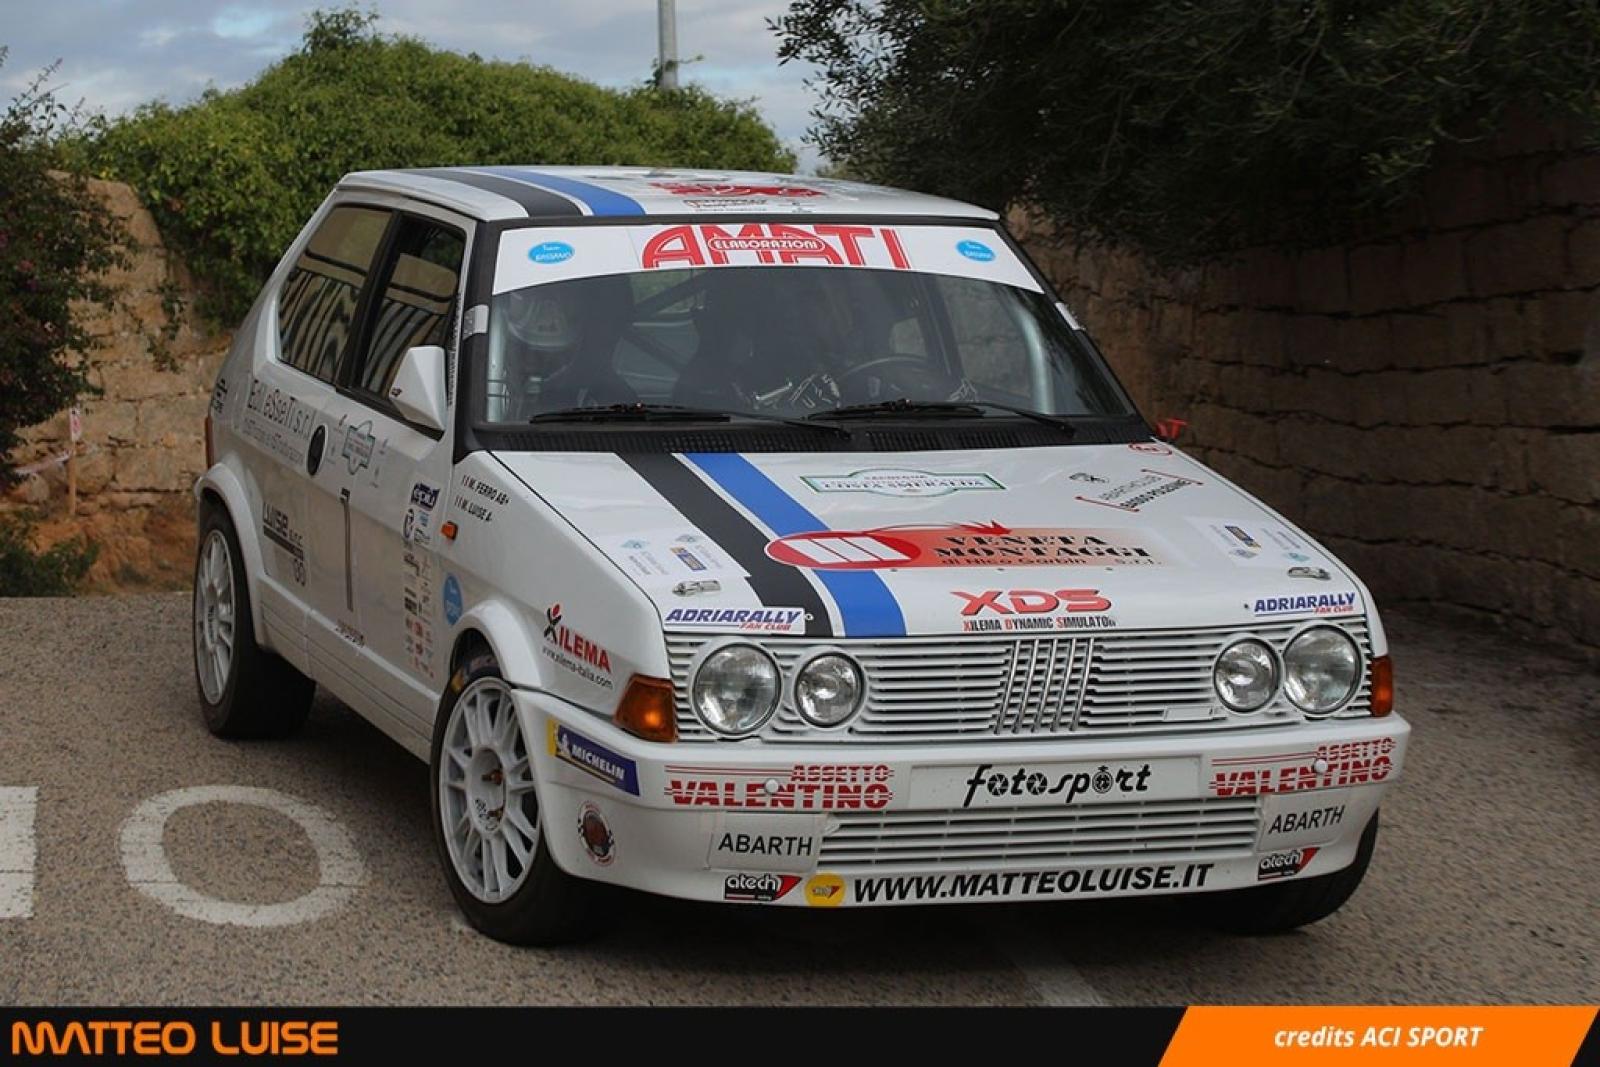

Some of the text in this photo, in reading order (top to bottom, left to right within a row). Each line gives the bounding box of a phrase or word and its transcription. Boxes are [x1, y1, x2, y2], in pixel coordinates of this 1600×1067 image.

[642, 224, 911, 269] AMATI
[711, 238, 820, 252] ELABORAZIONI
[468, 502, 487, 520] LUISE
[946, 535, 1108, 546] VENETA
[932, 546, 1151, 557] MONTAGGI
[965, 557, 1012, 565] Nico
[950, 588, 1112, 616] XDS
[1254, 592, 1356, 613] ADRIARALLY
[1314, 604, 1355, 615] FAN CLUB
[665, 608, 803, 624] ADRIARALLY
[963, 618, 1002, 632] XILEMA
[1004, 616, 1054, 631] DYNAMIC
[738, 622, 792, 632] FAN CLUB
[543, 604, 612, 675] XILEMA
[1317, 737, 1394, 762] ASSETTO
[571, 743, 626, 781] MICHELIN
[791, 763, 891, 782] ASSETTO
[963, 764, 1151, 808] fotosport
[1213, 755, 1394, 796] VALENTINO
[667, 780, 892, 809] VALENTINO
[1268, 804, 1346, 835] ABARTH
[718, 832, 813, 857] ABARTH
[1260, 849, 1301, 870] atech
[726, 872, 777, 890] atech
[854, 863, 1214, 903] WWW.MATTEOLUISE.IT
